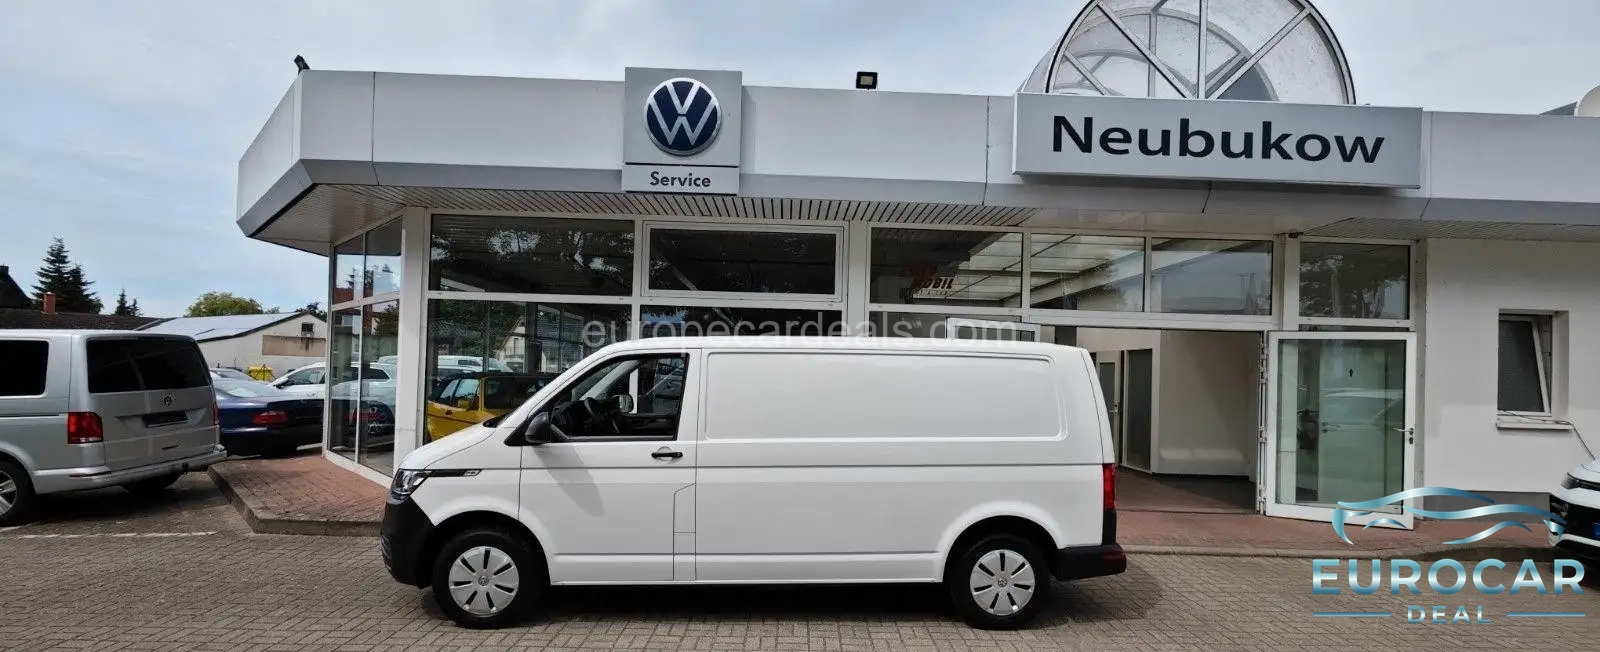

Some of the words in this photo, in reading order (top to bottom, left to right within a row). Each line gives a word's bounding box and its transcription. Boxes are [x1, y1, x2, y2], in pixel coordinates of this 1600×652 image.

[645, 78, 720, 153] VW
[1052, 115, 1386, 164] Neubukow
[649, 171, 712, 187] Service
